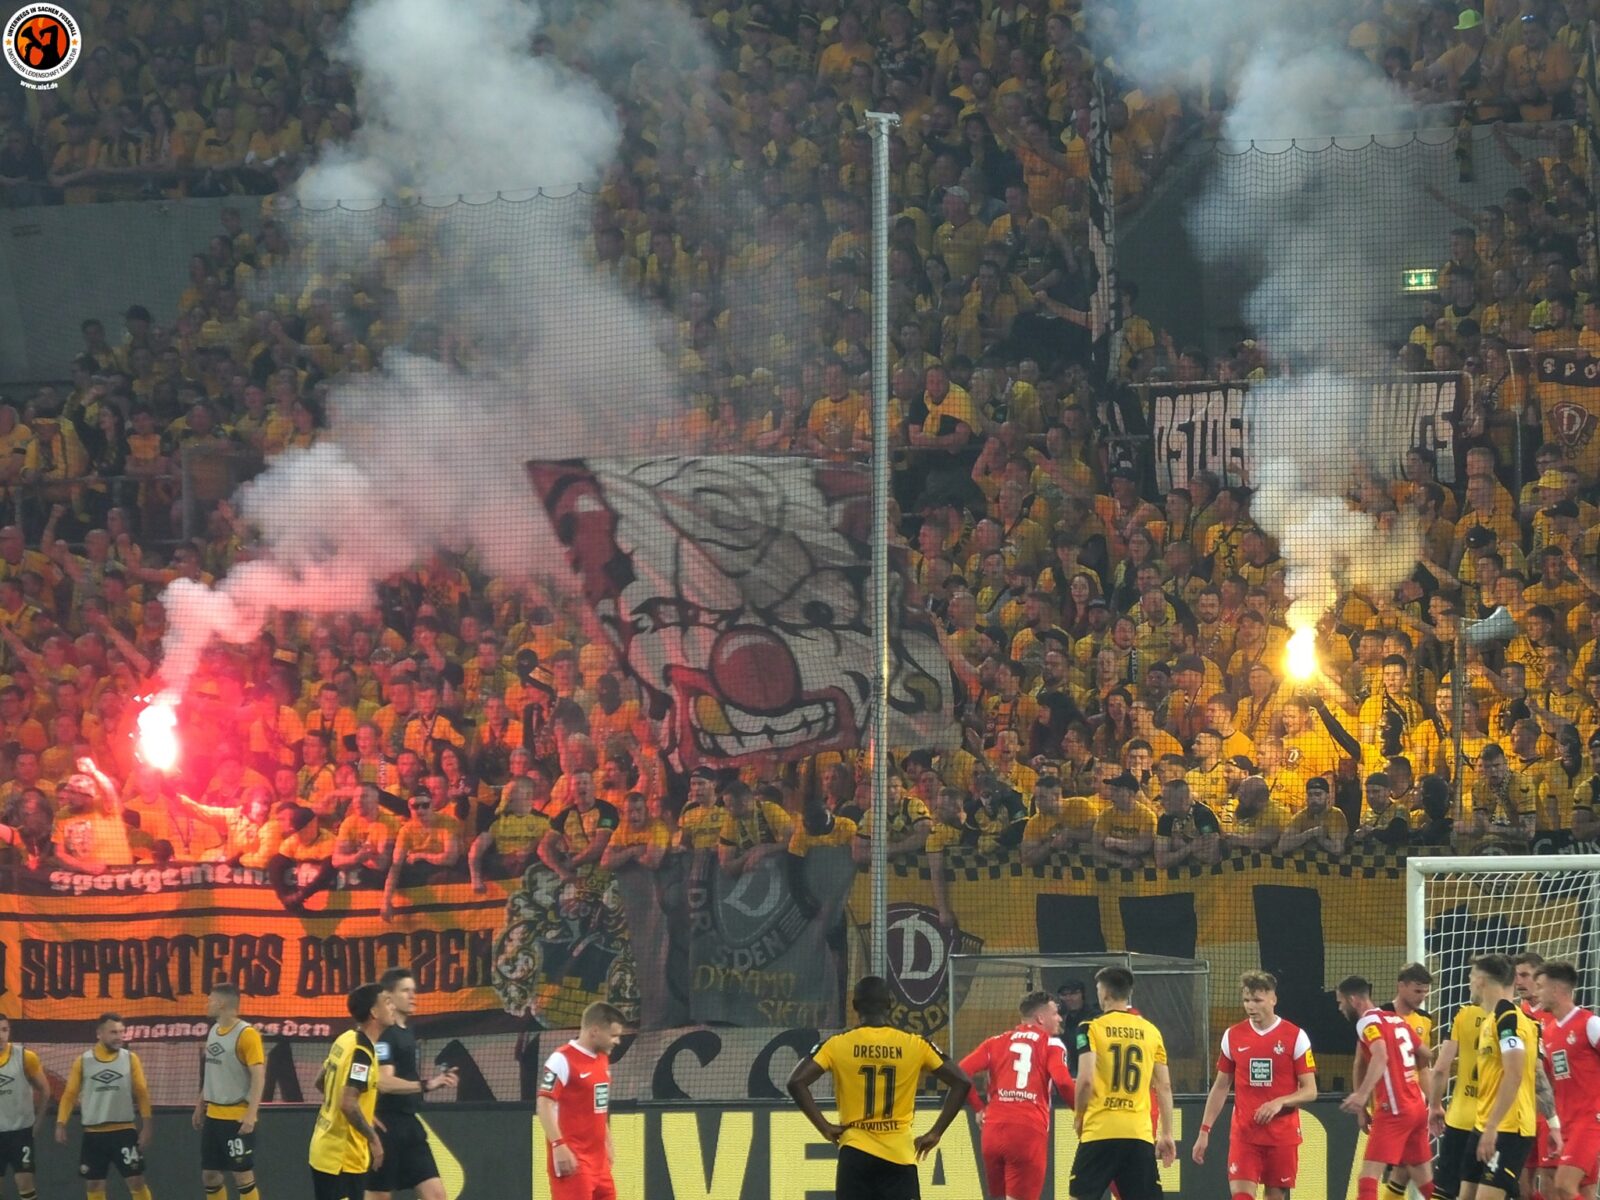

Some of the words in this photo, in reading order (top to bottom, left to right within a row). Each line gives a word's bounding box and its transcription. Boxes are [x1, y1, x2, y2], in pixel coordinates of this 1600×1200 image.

[1543, 358, 1600, 379] SPO
[20, 933, 284, 1000] SUPPORTERS
[299, 929, 495, 999] BAUTZEN
[121, 1020, 208, 1042] ynamo
[1106, 1025, 1145, 1041] DRESDEN
[853, 1045, 903, 1059] DRESDEN
[1395, 1027, 1417, 1067] 2
[1109, 1043, 1143, 1095] 16
[858, 1064, 897, 1121] 11
[997, 1088, 1038, 1101] Kemmler
[21, 1146, 30, 1163] 2
[121, 1147, 138, 1164] 34
[227, 1137, 243, 1158] 39
[531, 1111, 842, 1200] IVE
